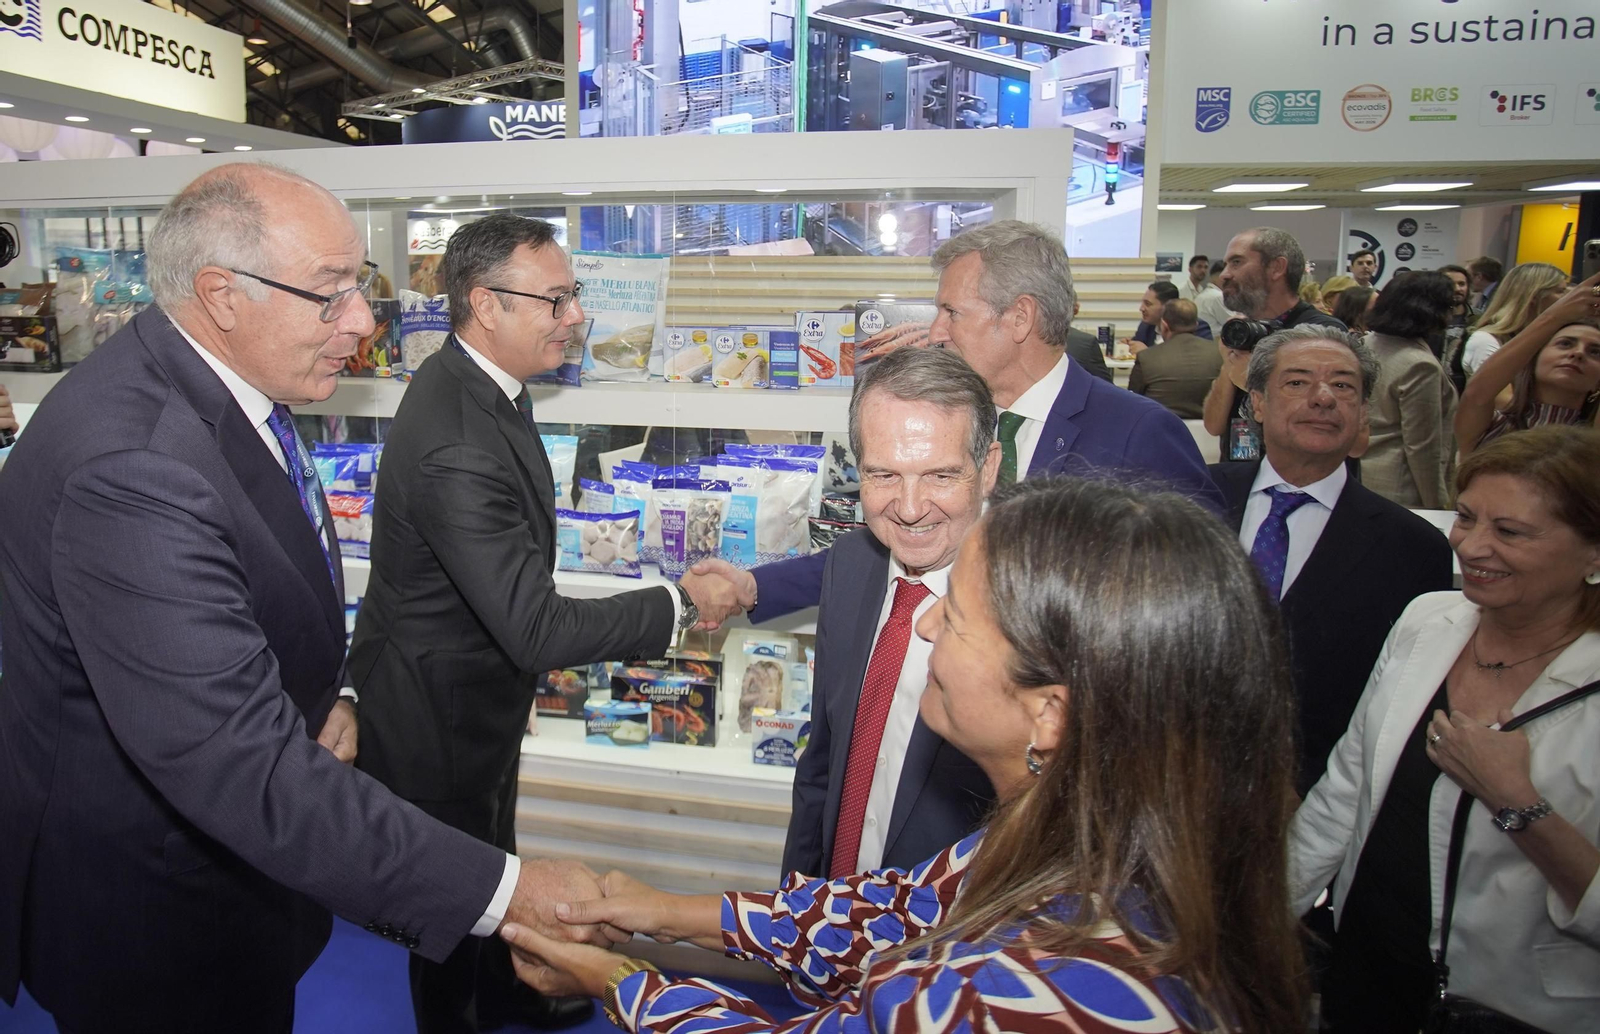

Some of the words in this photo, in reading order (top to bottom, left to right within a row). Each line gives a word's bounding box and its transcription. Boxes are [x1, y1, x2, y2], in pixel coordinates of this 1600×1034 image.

[1322, 16, 1357, 46] in
[1373, 23, 1394, 45] a
[1410, 9, 1596, 44] sustaina
[58, 7, 215, 79] COMPESCA
[1199, 89, 1230, 101] MSC
[1283, 92, 1318, 107] asc
[1347, 102, 1386, 111] ecovadis
[1511, 94, 1546, 111] IFS
[803, 329, 823, 337] Extra
[763, 721, 794, 730] CONAD
